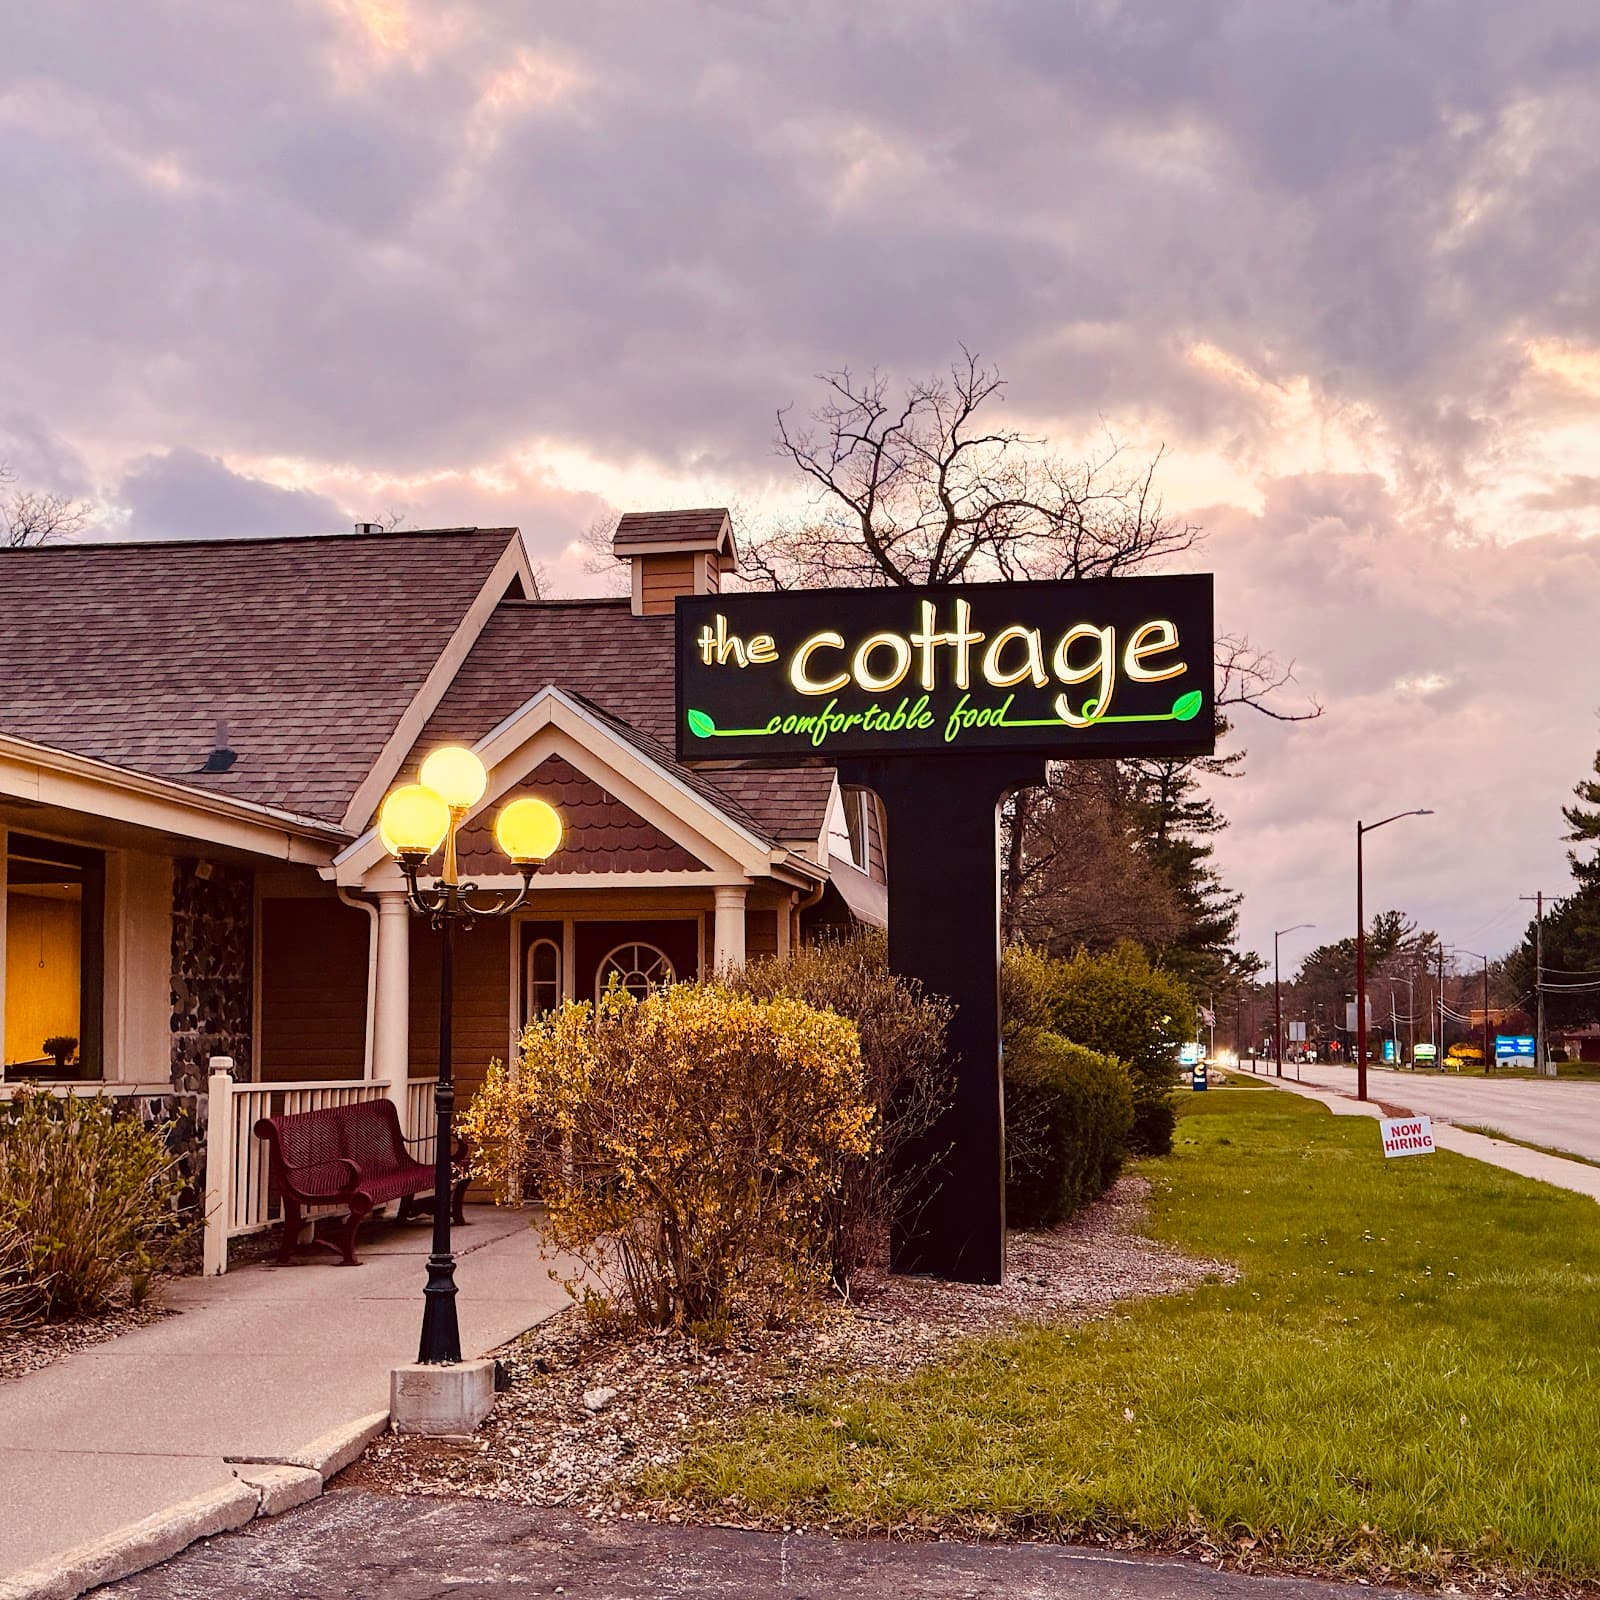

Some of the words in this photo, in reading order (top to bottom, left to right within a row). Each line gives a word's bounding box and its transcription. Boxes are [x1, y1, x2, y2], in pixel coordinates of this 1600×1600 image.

[698, 614, 779, 668] the
[790, 598, 1188, 729] cottage
[766, 695, 935, 746] comfortable
[944, 693, 1015, 742] food
[1385, 1135, 1433, 1151] HIRING
[1391, 1123, 1422, 1138] NOW
